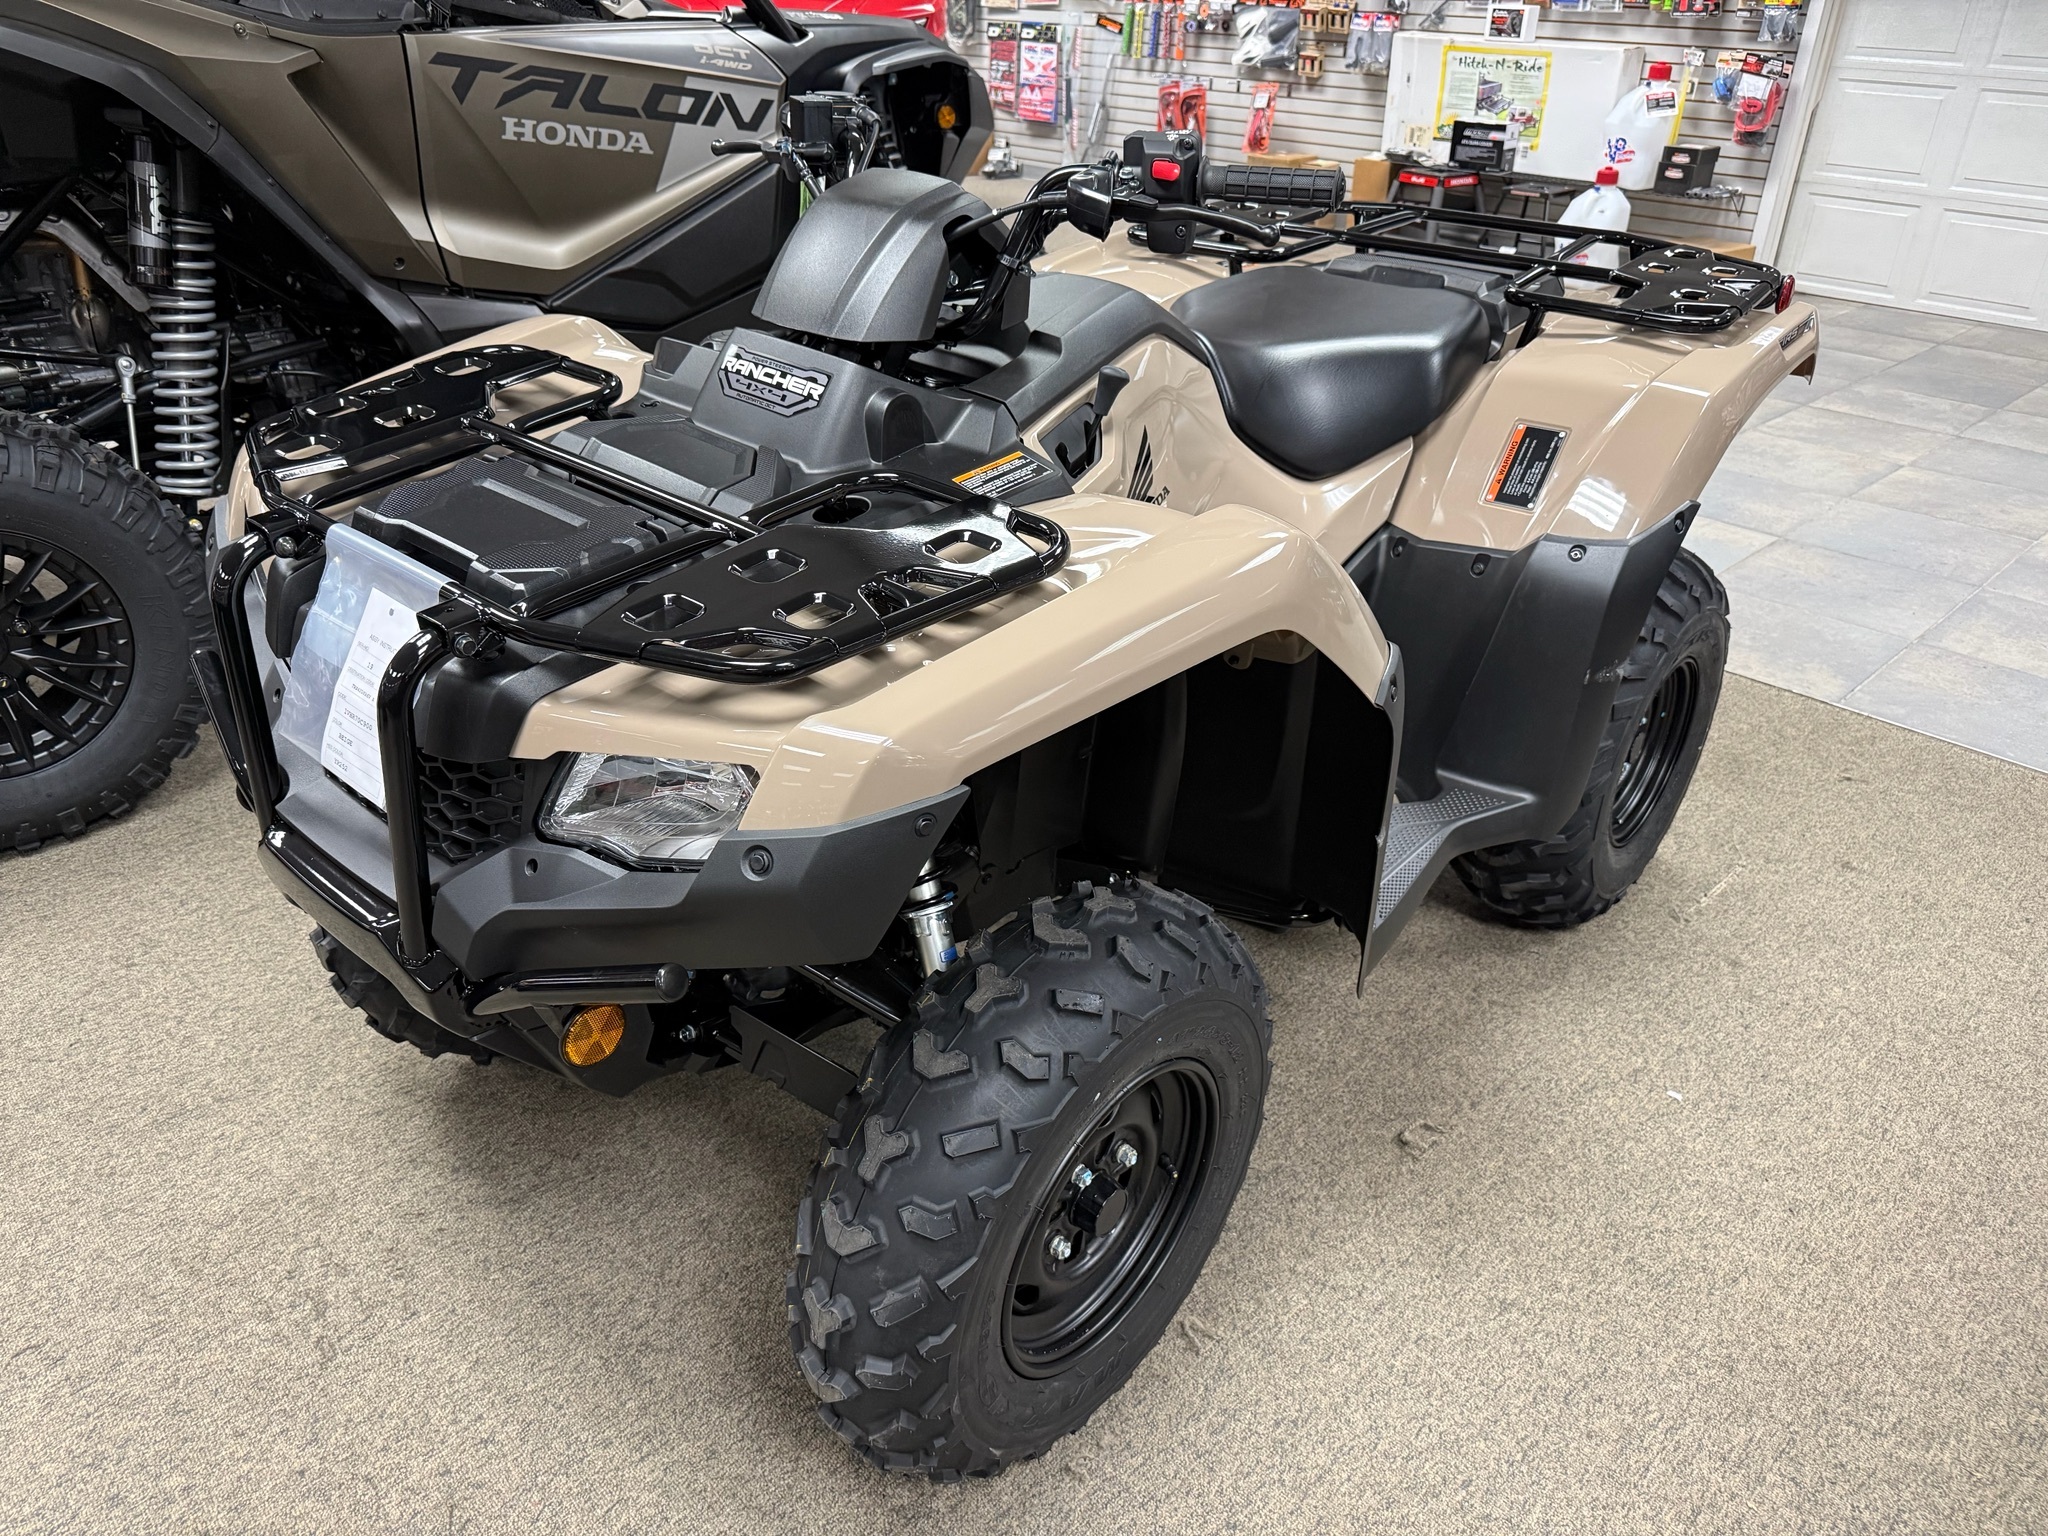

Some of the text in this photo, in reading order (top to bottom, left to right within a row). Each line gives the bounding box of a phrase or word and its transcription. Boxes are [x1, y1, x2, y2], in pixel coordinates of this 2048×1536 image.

[692, 43, 751, 60] DCT
[1458, 56, 1543, 73] Hitch-N-Ride
[428, 51, 776, 132] TALON
[501, 116, 655, 156] HONDA
[720, 356, 826, 401] RANCHER
[751, 356, 795, 374] POWER STEERING
[1498, 440, 1520, 477] WARNING
